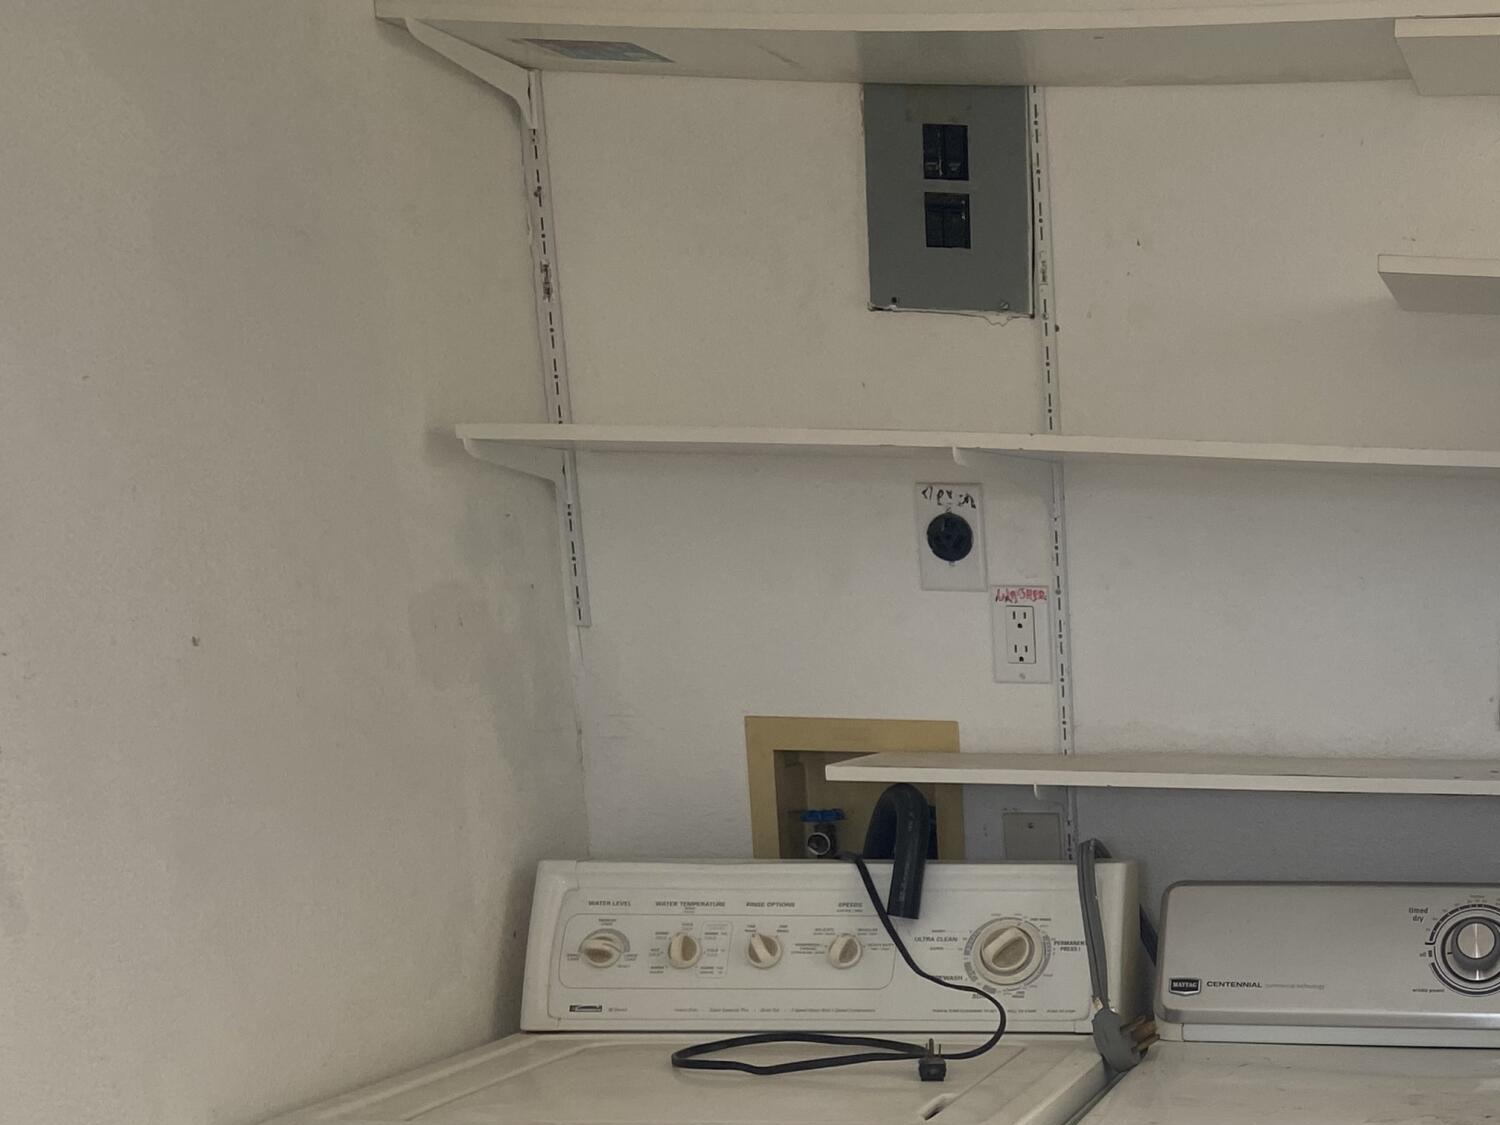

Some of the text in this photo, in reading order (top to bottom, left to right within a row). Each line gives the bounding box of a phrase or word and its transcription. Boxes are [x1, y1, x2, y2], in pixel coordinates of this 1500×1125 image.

[1412, 914, 1425, 924] dry
[1172, 981, 1198, 989] MAYTAG
[1206, 980, 1263, 989] CENTENNIAL
